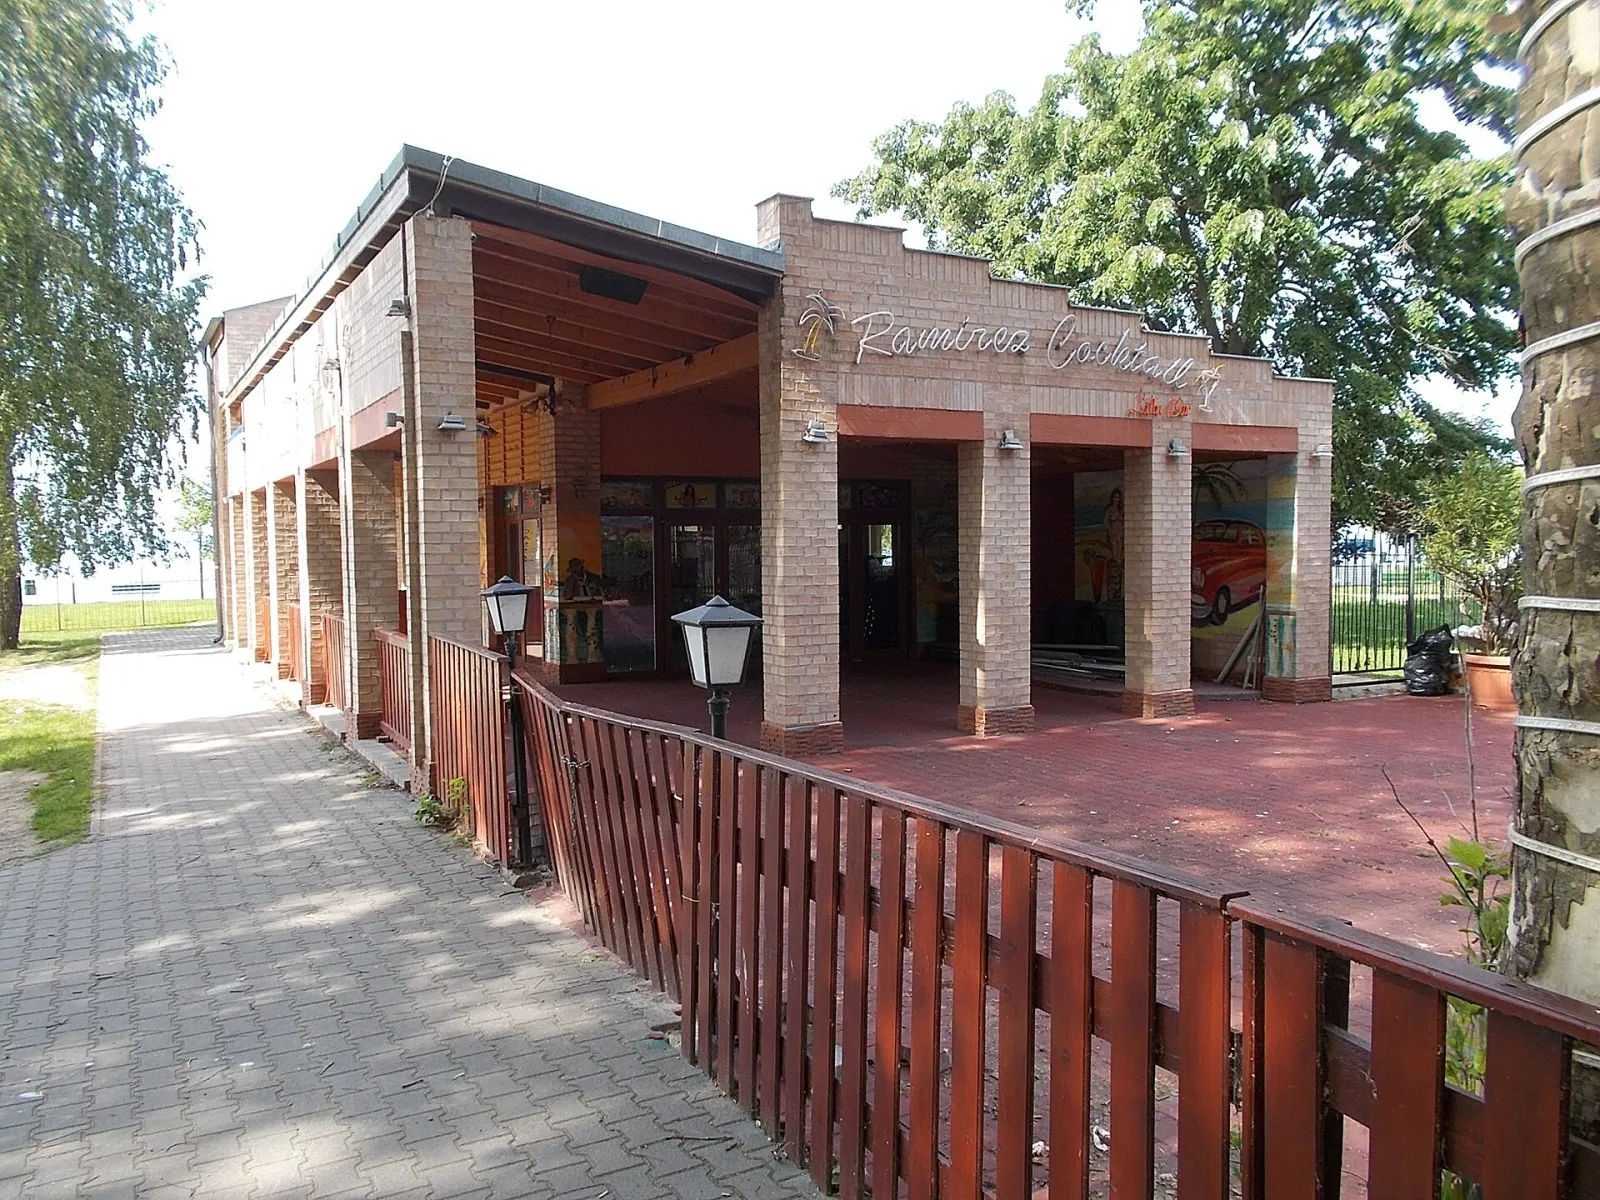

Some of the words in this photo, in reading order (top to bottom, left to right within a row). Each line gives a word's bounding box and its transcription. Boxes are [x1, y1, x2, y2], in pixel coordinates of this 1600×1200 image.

[851, 311, 1030, 364] Ramirez
[1047, 314, 1194, 388] Cocktail
[1167, 395, 1192, 418] Bar
